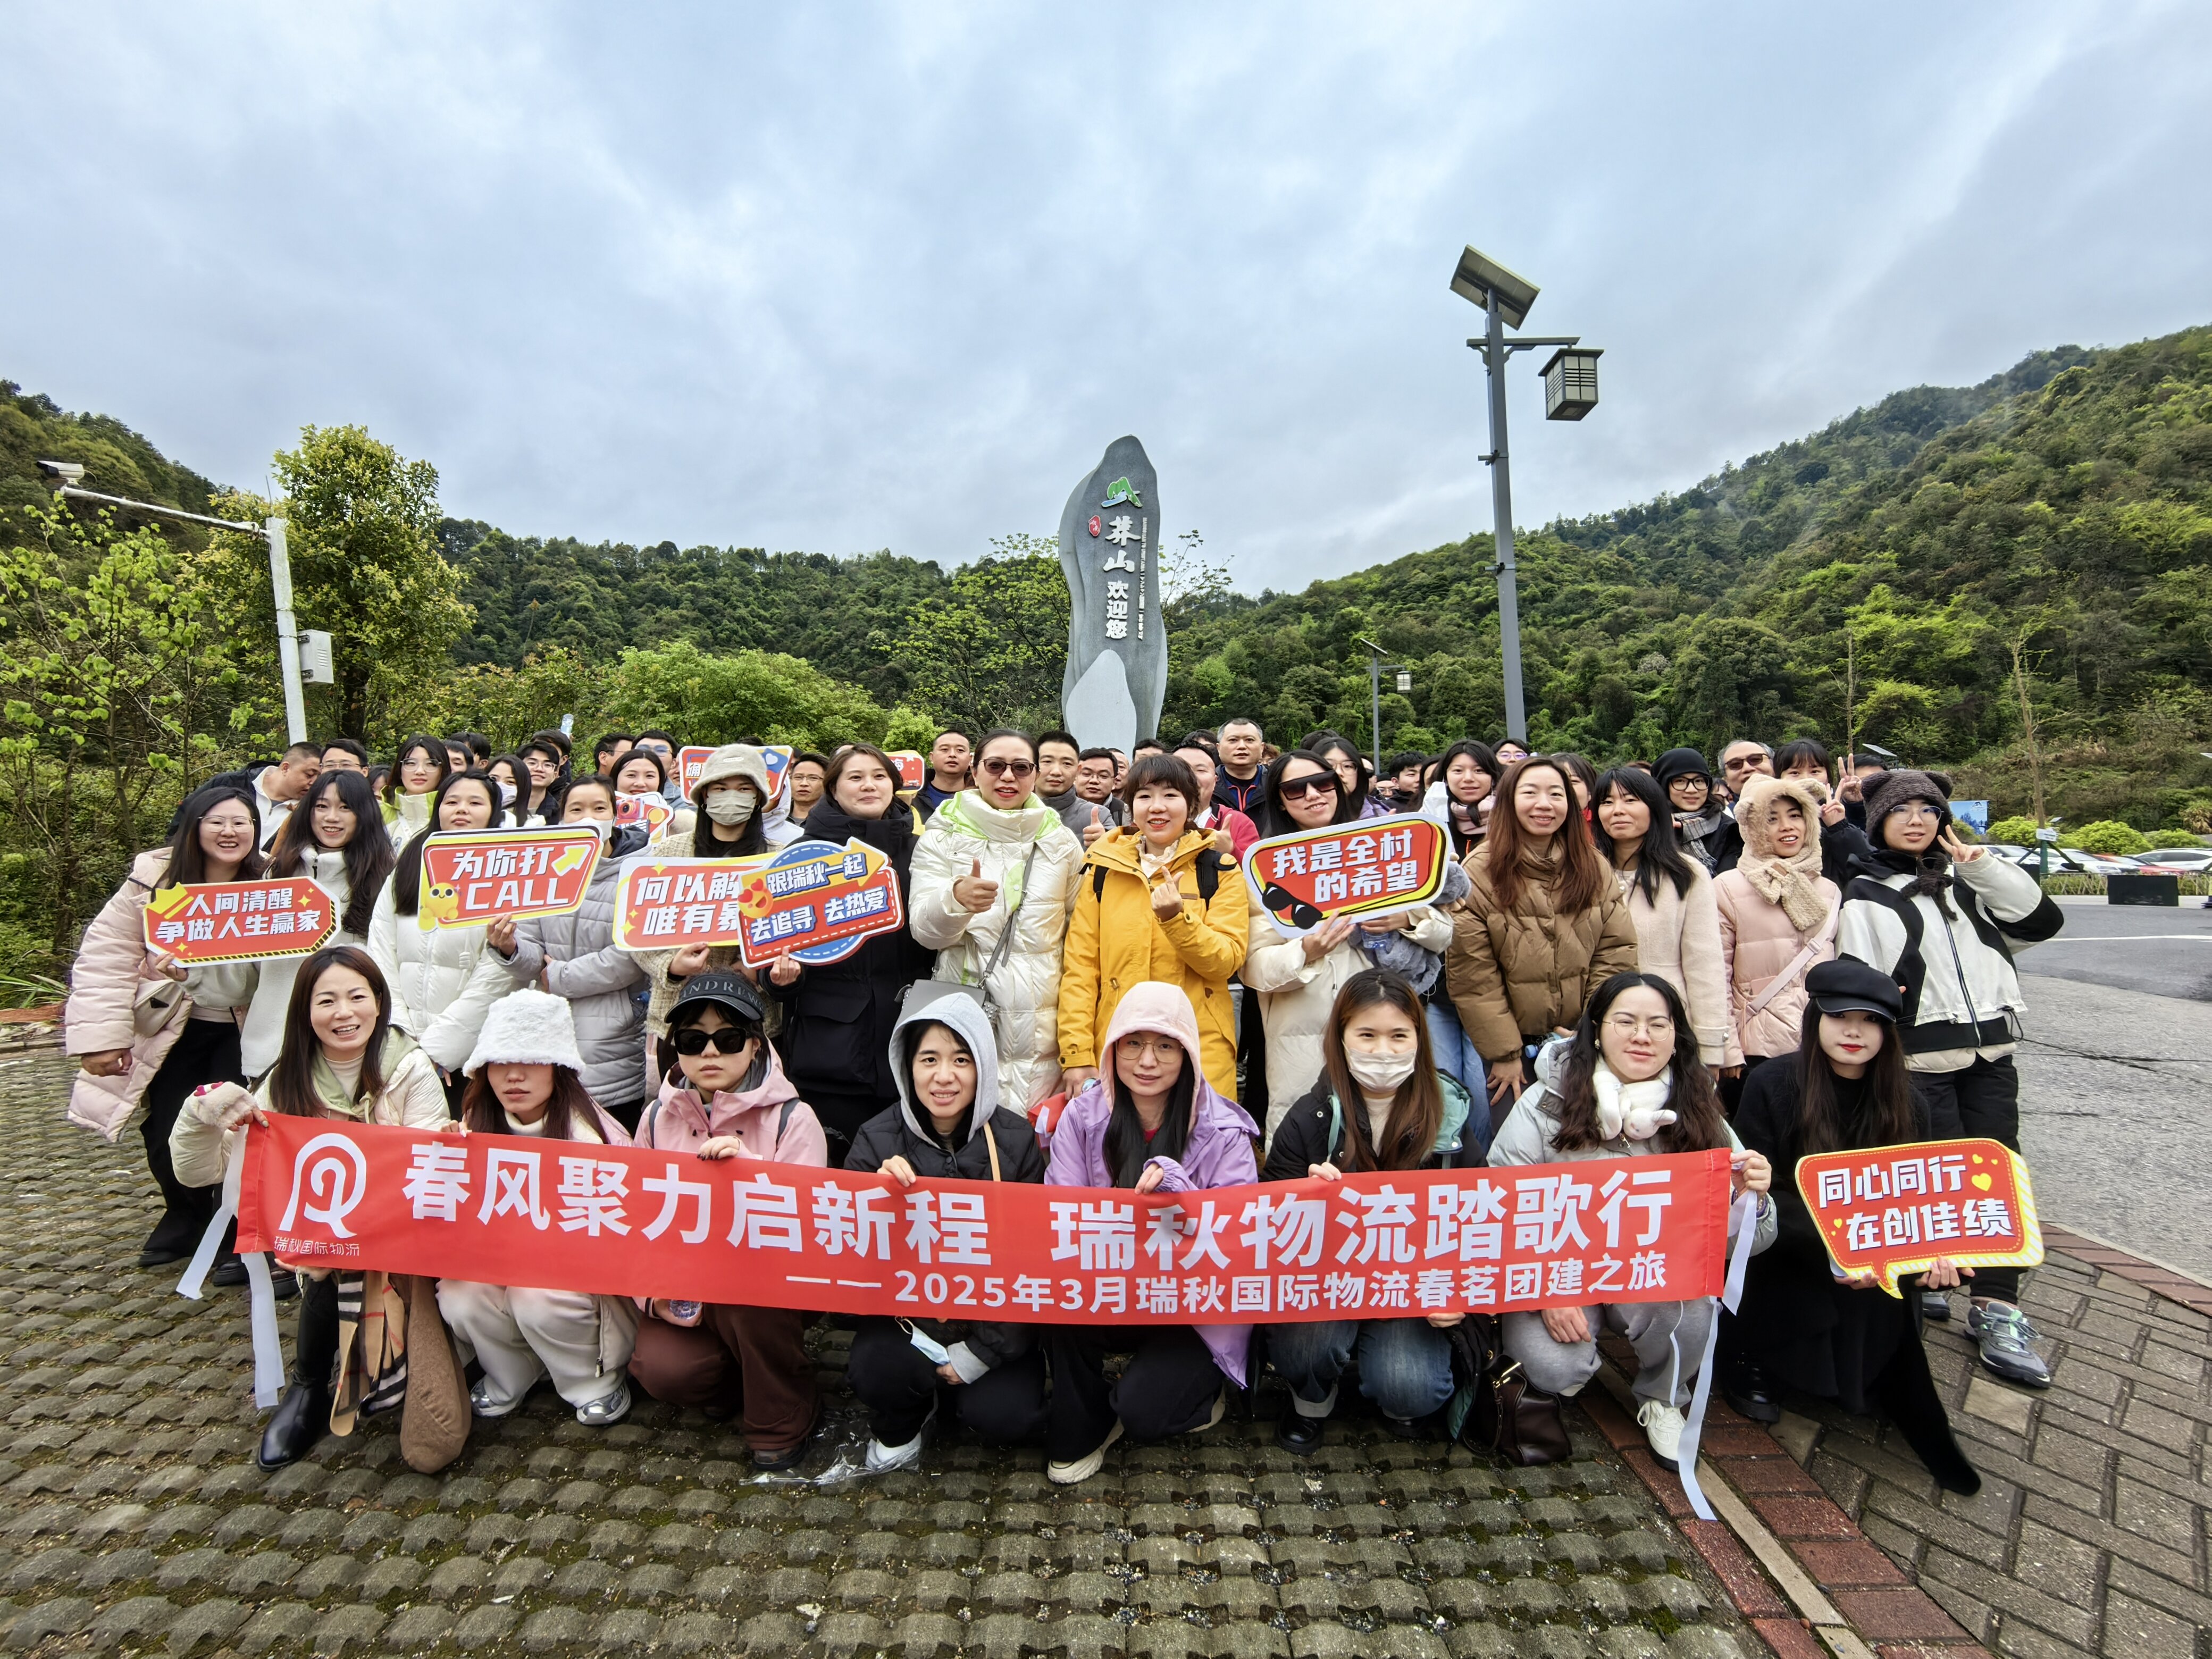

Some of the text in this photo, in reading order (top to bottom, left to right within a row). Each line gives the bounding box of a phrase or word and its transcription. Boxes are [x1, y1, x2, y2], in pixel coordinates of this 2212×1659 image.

[451, 846, 555, 880] 为你打
[766, 853, 864, 894] 跟瑞秋一起
[1272, 828, 1413, 879] 我是全村
[186, 887, 294, 917] 人间清醒
[465, 878, 569, 910] CALL
[1314, 860, 1418, 903] 的希望
[155, 910, 321, 943] 争做人生赢家
[750, 886, 885, 943] 去追寻 去热爱
[1817, 1154, 1966, 1209] 同心同行
[402, 1141, 1672, 1271] 春风聚力启新程 瑞秋物流踏歌行
[1846, 1198, 2015, 1251] 在创佳绩
[274, 1236, 360, 1256] 瑞秋国际物流
